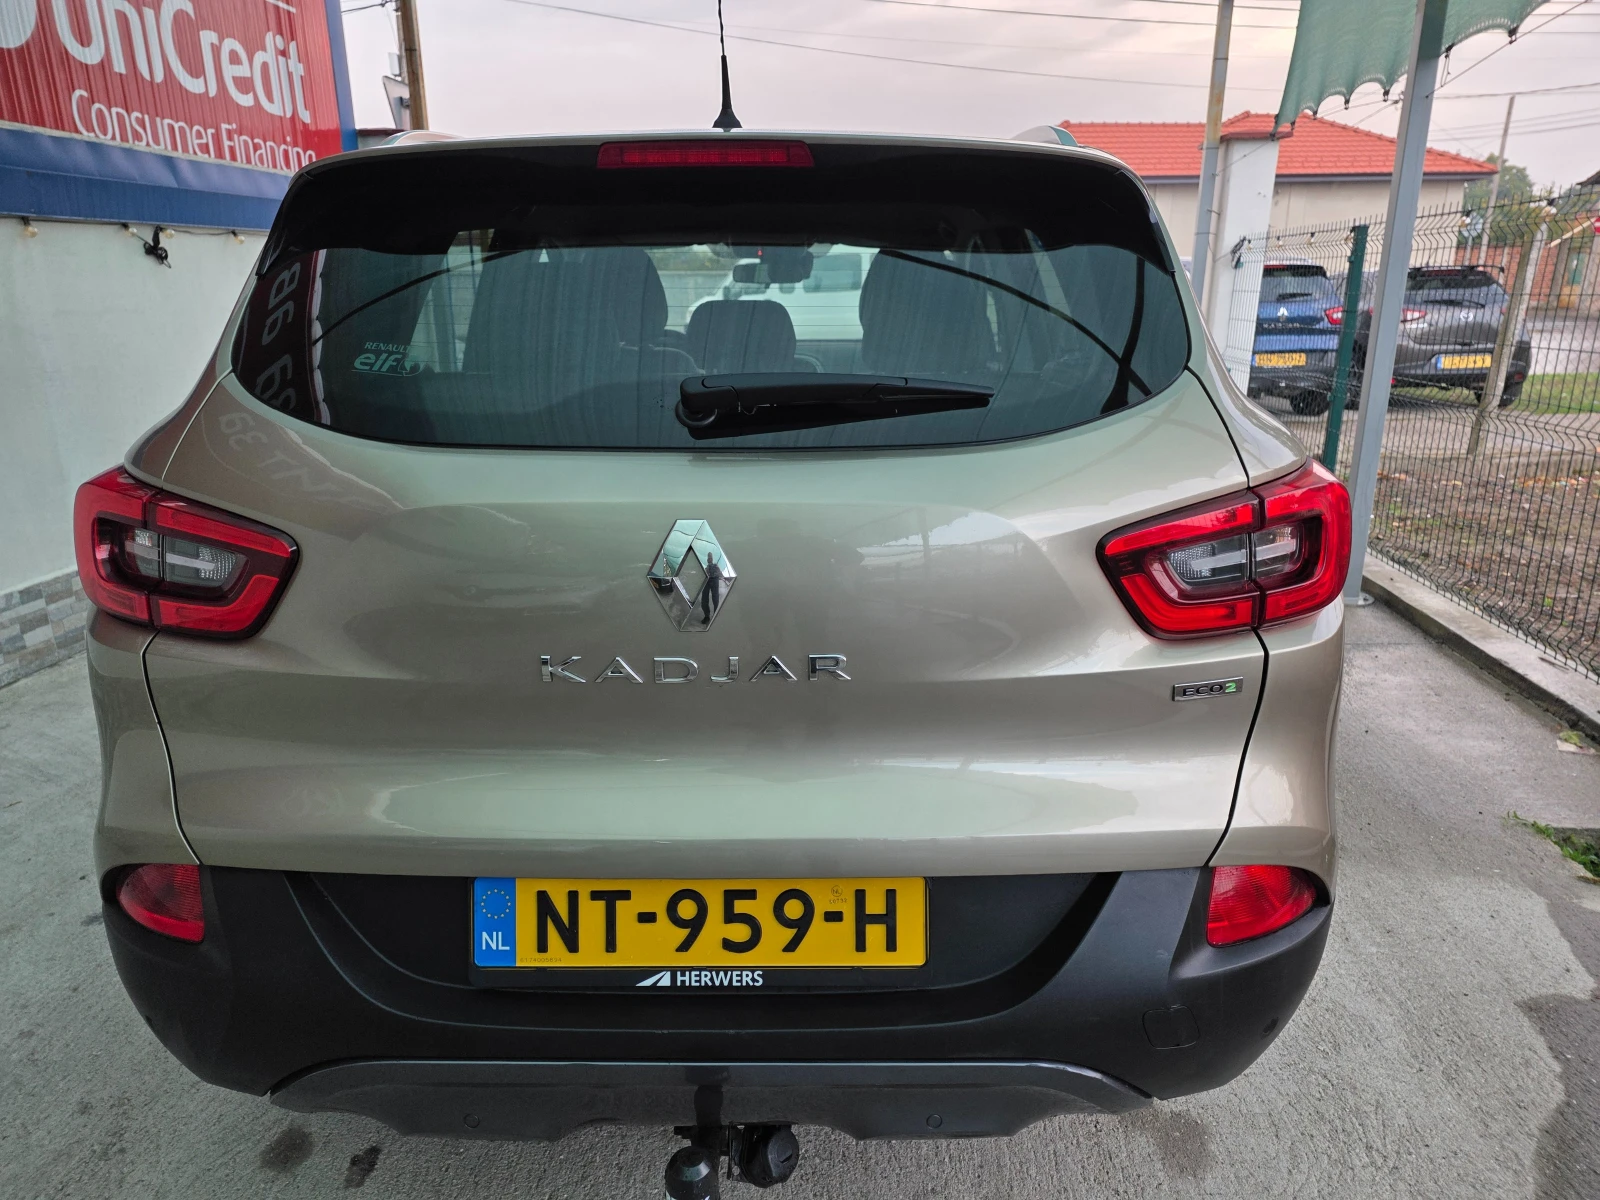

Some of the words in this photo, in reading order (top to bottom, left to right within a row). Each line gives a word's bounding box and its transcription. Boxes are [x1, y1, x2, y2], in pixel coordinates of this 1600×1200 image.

[51, 0, 310, 123] UniCredit
[72, 88, 216, 158] Consumer
[364, 341, 412, 353] RENAULT
[353, 352, 403, 372] elf
[540, 653, 852, 683] KADJAR
[536, 888, 898, 954] NT-959-H
[481, 931, 510, 951] NL
[676, 970, 764, 987] HERWERS
